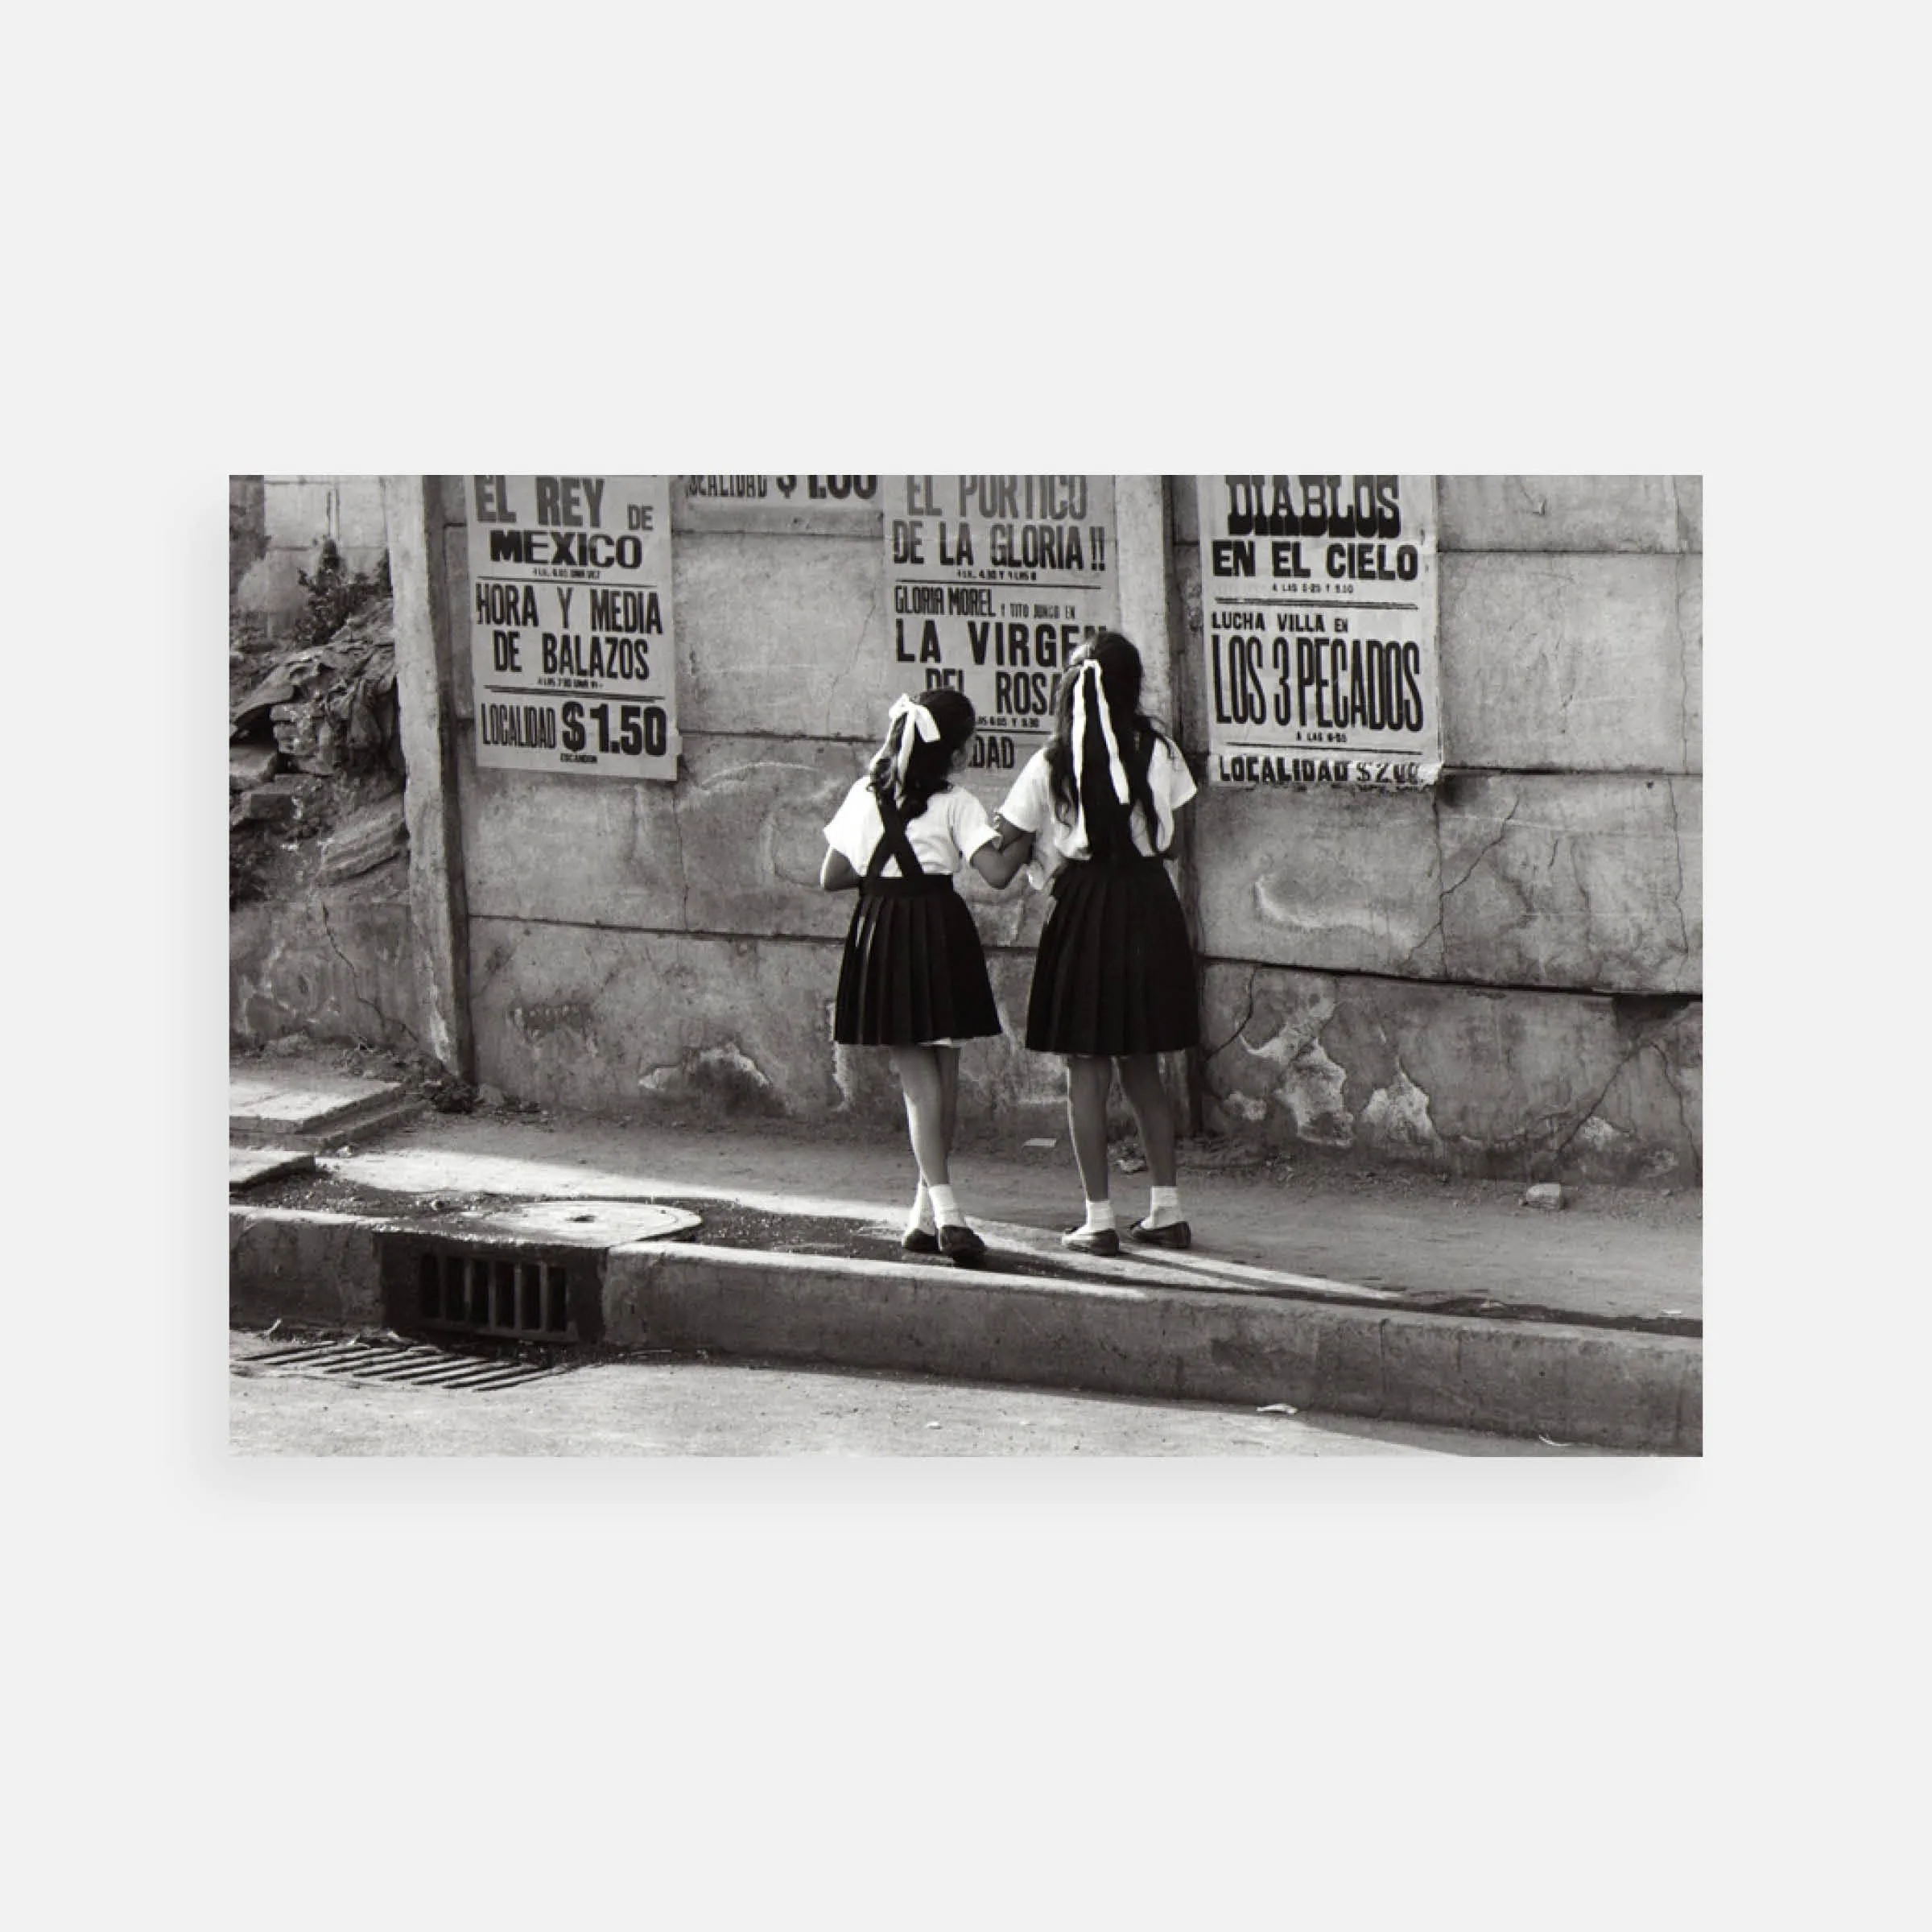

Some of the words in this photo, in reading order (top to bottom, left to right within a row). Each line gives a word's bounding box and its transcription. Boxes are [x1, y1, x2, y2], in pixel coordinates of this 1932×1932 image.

[474, 475, 516, 523] EL
[535, 476, 605, 529] REY
[627, 503, 654, 531] DE
[907, 475, 943, 516] EL
[1226, 475, 1402, 538] DIABLOS
[489, 529, 642, 570] MEXICO
[894, 519, 924, 564] DE
[939, 521, 974, 566] LA
[1212, 540, 1256, 577] EN
[1271, 541, 1311, 579] EL
[1327, 543, 1419, 580] CIELO
[475, 583, 539, 627] HORA
[557, 587, 574, 629] Y
[589, 588, 663, 635] MEDIA
[894, 585, 945, 616] GLORIA
[948, 588, 997, 617] MOREL
[1212, 611, 1266, 632] LUCHA
[1277, 612, 1327, 634] VILLA
[1333, 618, 1349, 633] EN
[493, 630, 522, 673] DE
[541, 633, 650, 681] BALAZOS
[896, 618, 942, 664] LA
[967, 620, 1107, 668] VIRGE
[1212, 634, 1267, 725] LOS
[1273, 637, 1291, 726] 3
[1297, 637, 1424, 733] PECADOS
[481, 702, 556, 749] LOCALIDAD
[1218, 753, 1351, 784] LOCALIDAD
